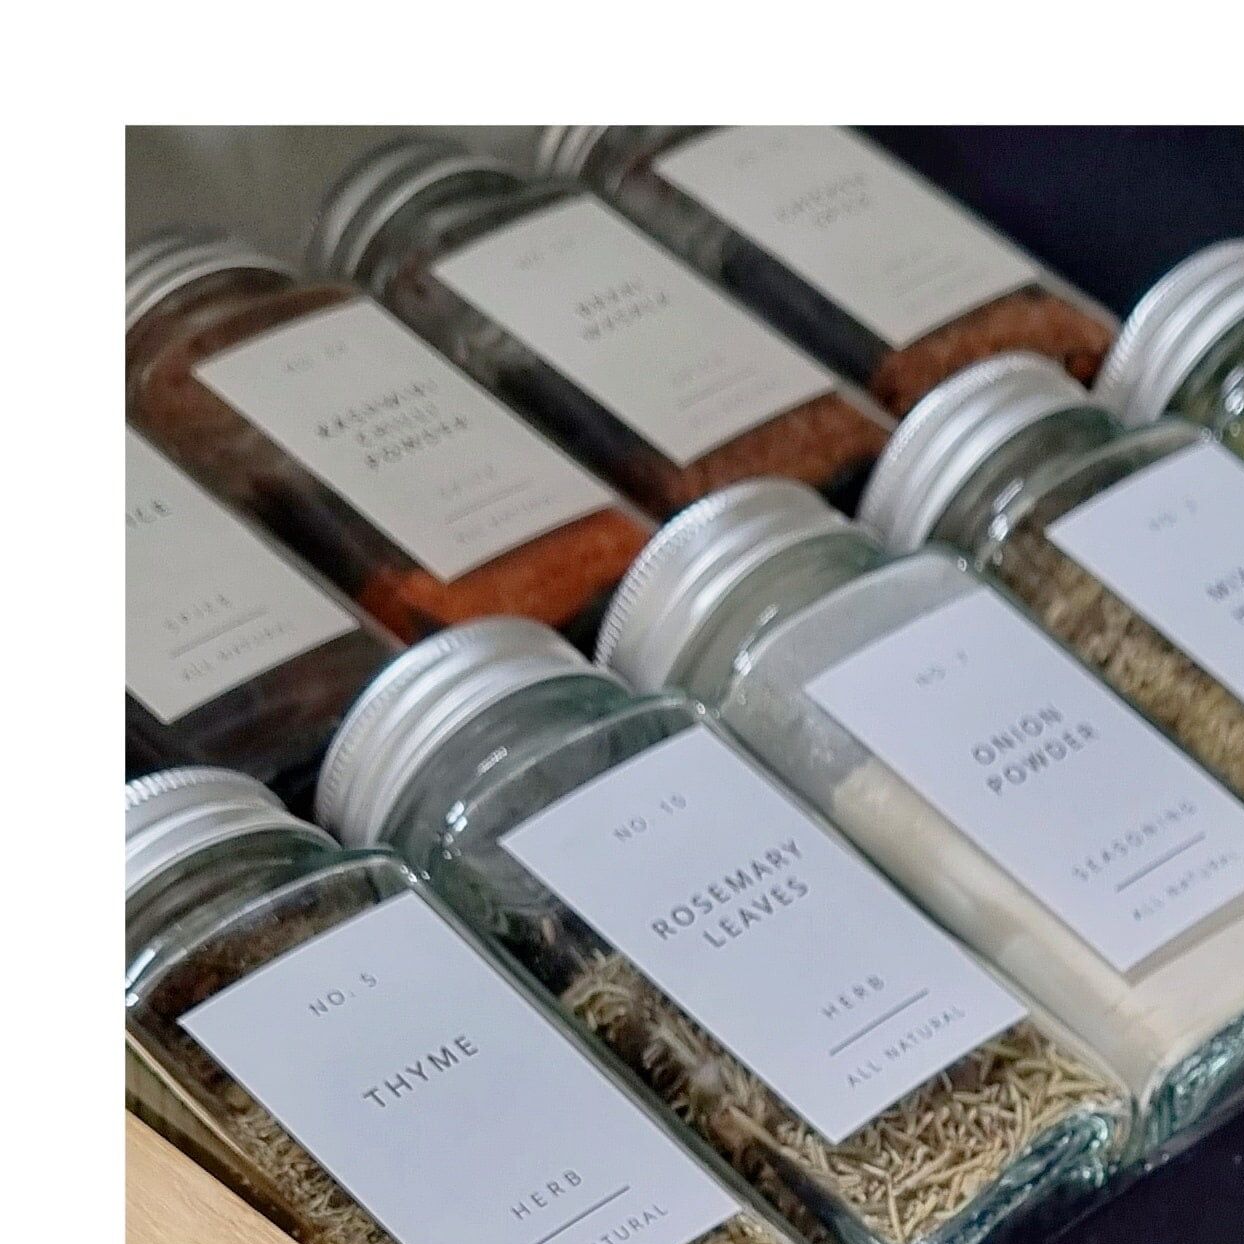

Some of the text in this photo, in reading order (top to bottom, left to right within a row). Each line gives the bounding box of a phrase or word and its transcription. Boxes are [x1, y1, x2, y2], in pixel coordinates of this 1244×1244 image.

[969, 703, 1063, 766] ONION
[984, 722, 1097, 797] POWDER
[1070, 799, 1197, 882] SEASONING
[649, 838, 802, 941] ROSEMARY
[701, 876, 809, 949] LEAVES
[306, 971, 377, 1017] NO. 5
[820, 974, 885, 1020] HERB
[361, 1034, 479, 1108] THYME
[845, 1005, 966, 1089] ALL NATURAL
[509, 1169, 582, 1221] HERB
